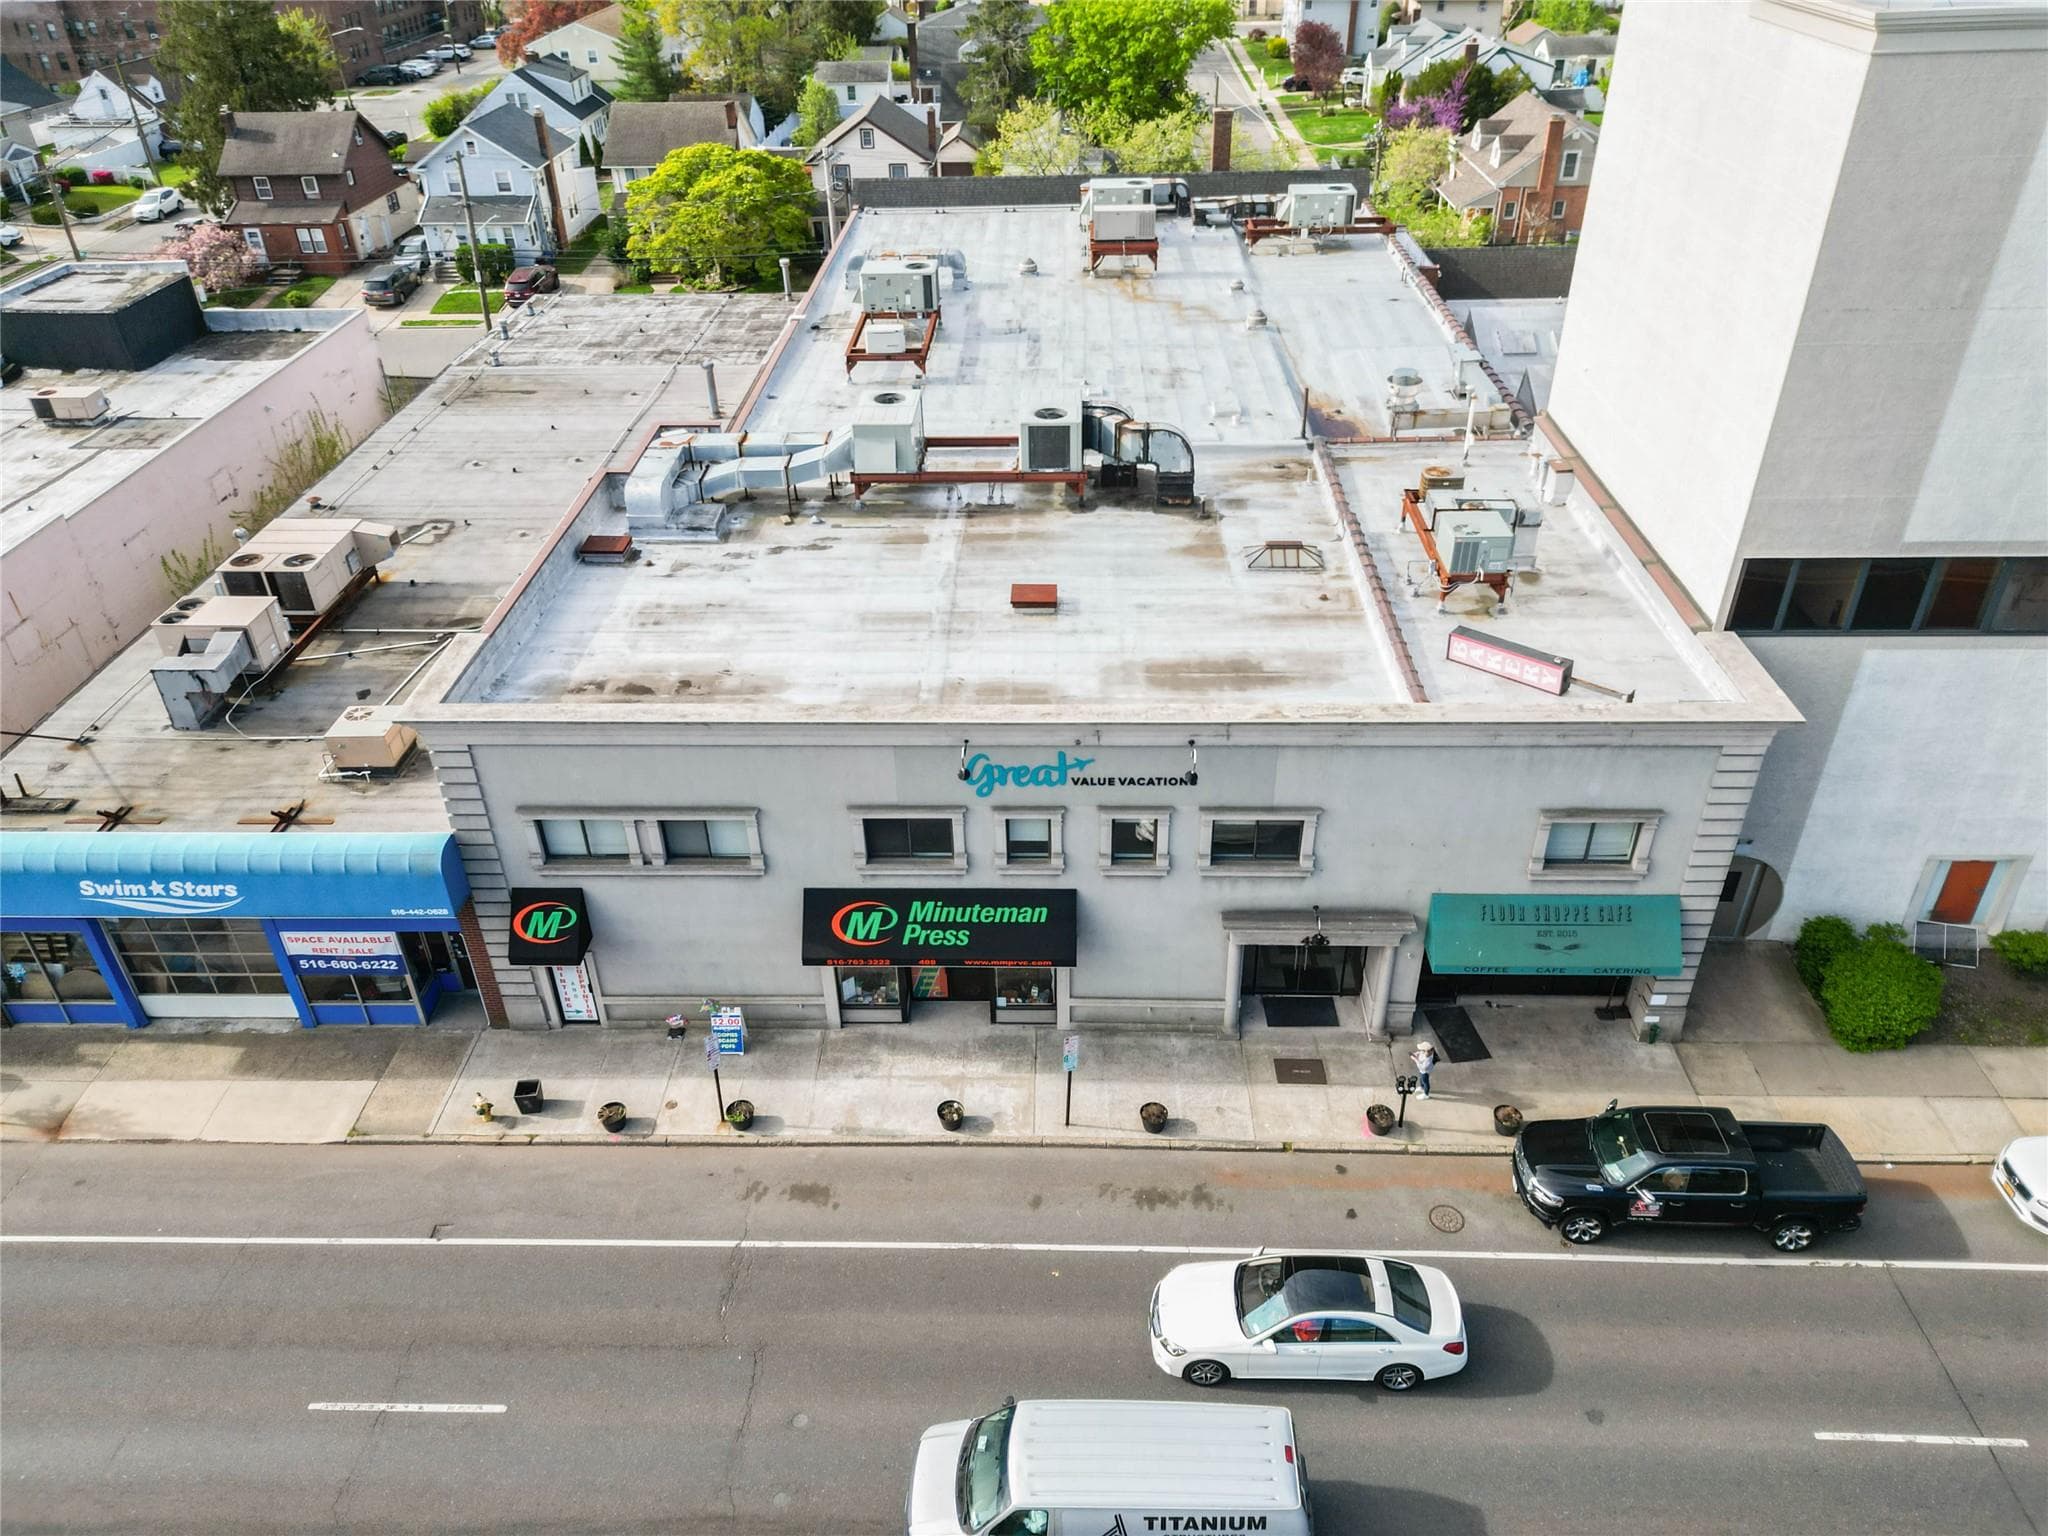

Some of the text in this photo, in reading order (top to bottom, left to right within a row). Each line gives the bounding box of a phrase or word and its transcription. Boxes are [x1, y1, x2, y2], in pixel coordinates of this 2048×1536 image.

[966, 750, 1197, 798] Great VALUE VACATION
[79, 879, 238, 897] Swim Stars
[907, 900, 1049, 923] Minuteman
[1480, 904, 1633, 922] FLOUR SHOPPE CAFE
[286, 935, 394, 944] SPACE AVAILABLE
[901, 923, 971, 946] Press
[1556, 930, 1579, 938] 2015
[299, 959, 400, 970] 516-680-6222
[1463, 966, 1652, 975] COFFEE CAFE CATERING
[1143, 1516, 1268, 1531] TITANIUM
